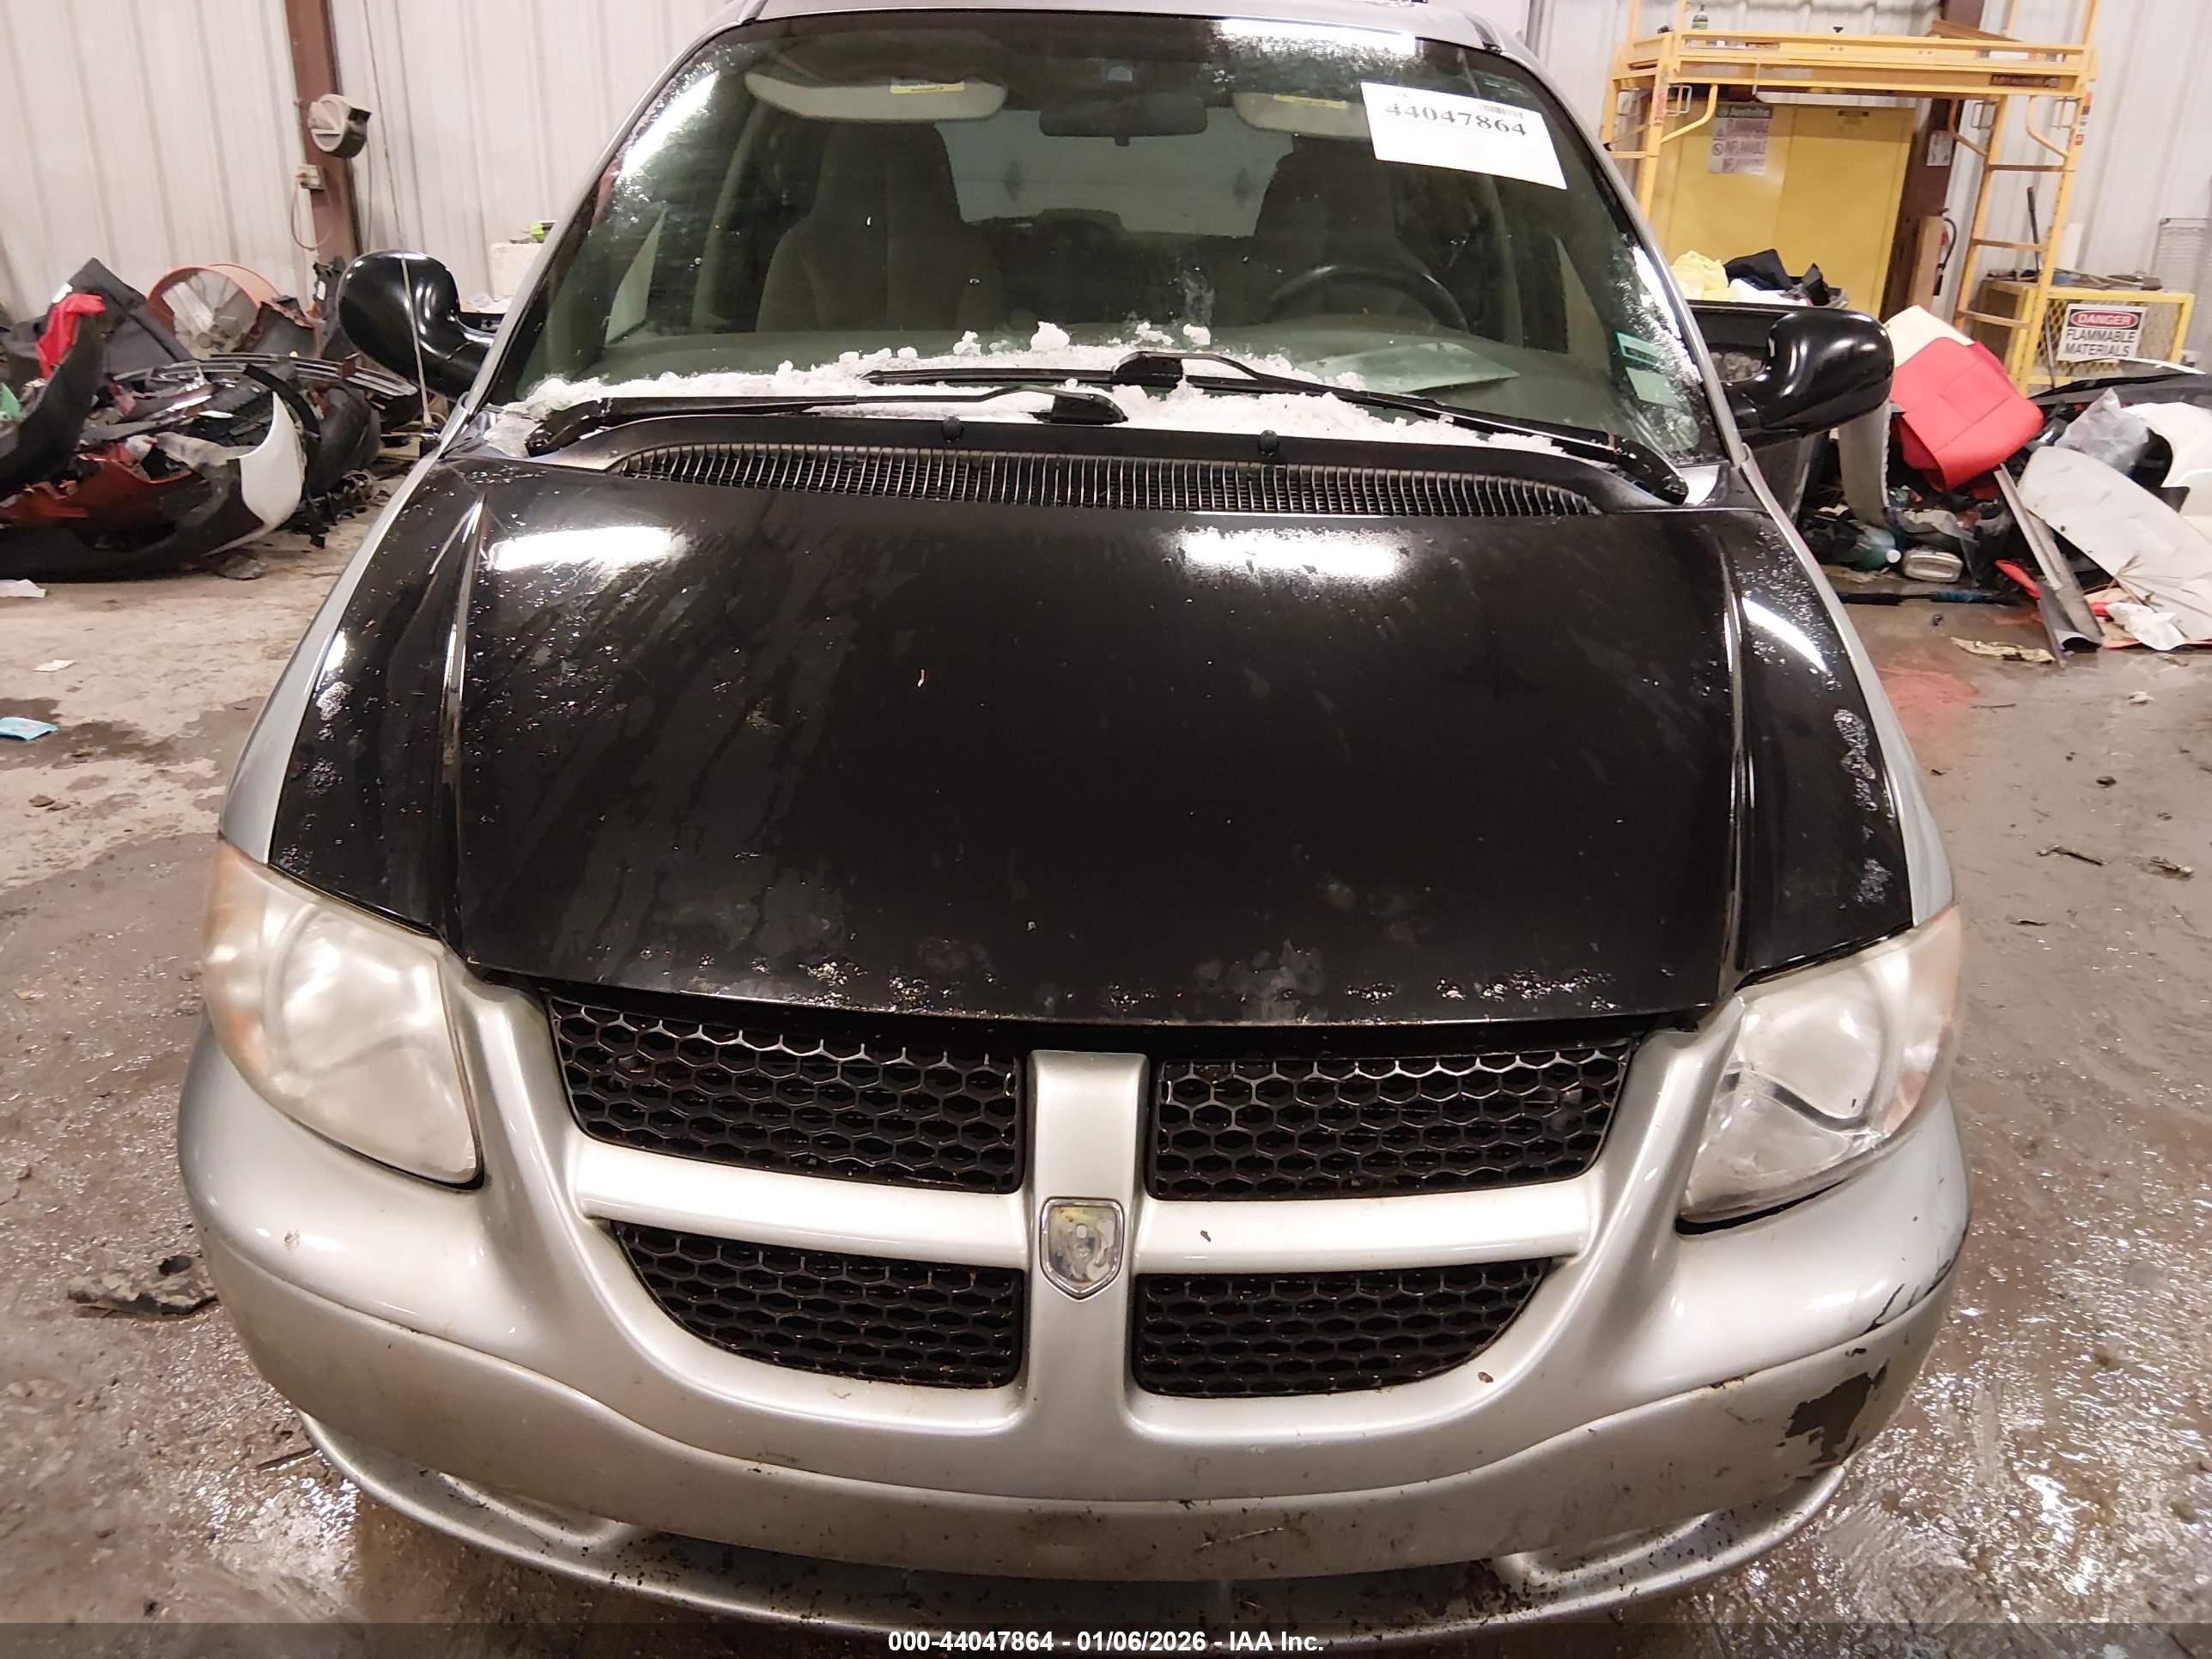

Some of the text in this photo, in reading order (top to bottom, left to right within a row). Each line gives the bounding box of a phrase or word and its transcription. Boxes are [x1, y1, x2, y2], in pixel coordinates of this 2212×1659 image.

[1385, 103, 1527, 136] 44047864
[2077, 313, 2132, 325] DANGER
[2066, 329, 2136, 343] FLAMMABLE
[2063, 343, 2130, 357] MATERIALS
